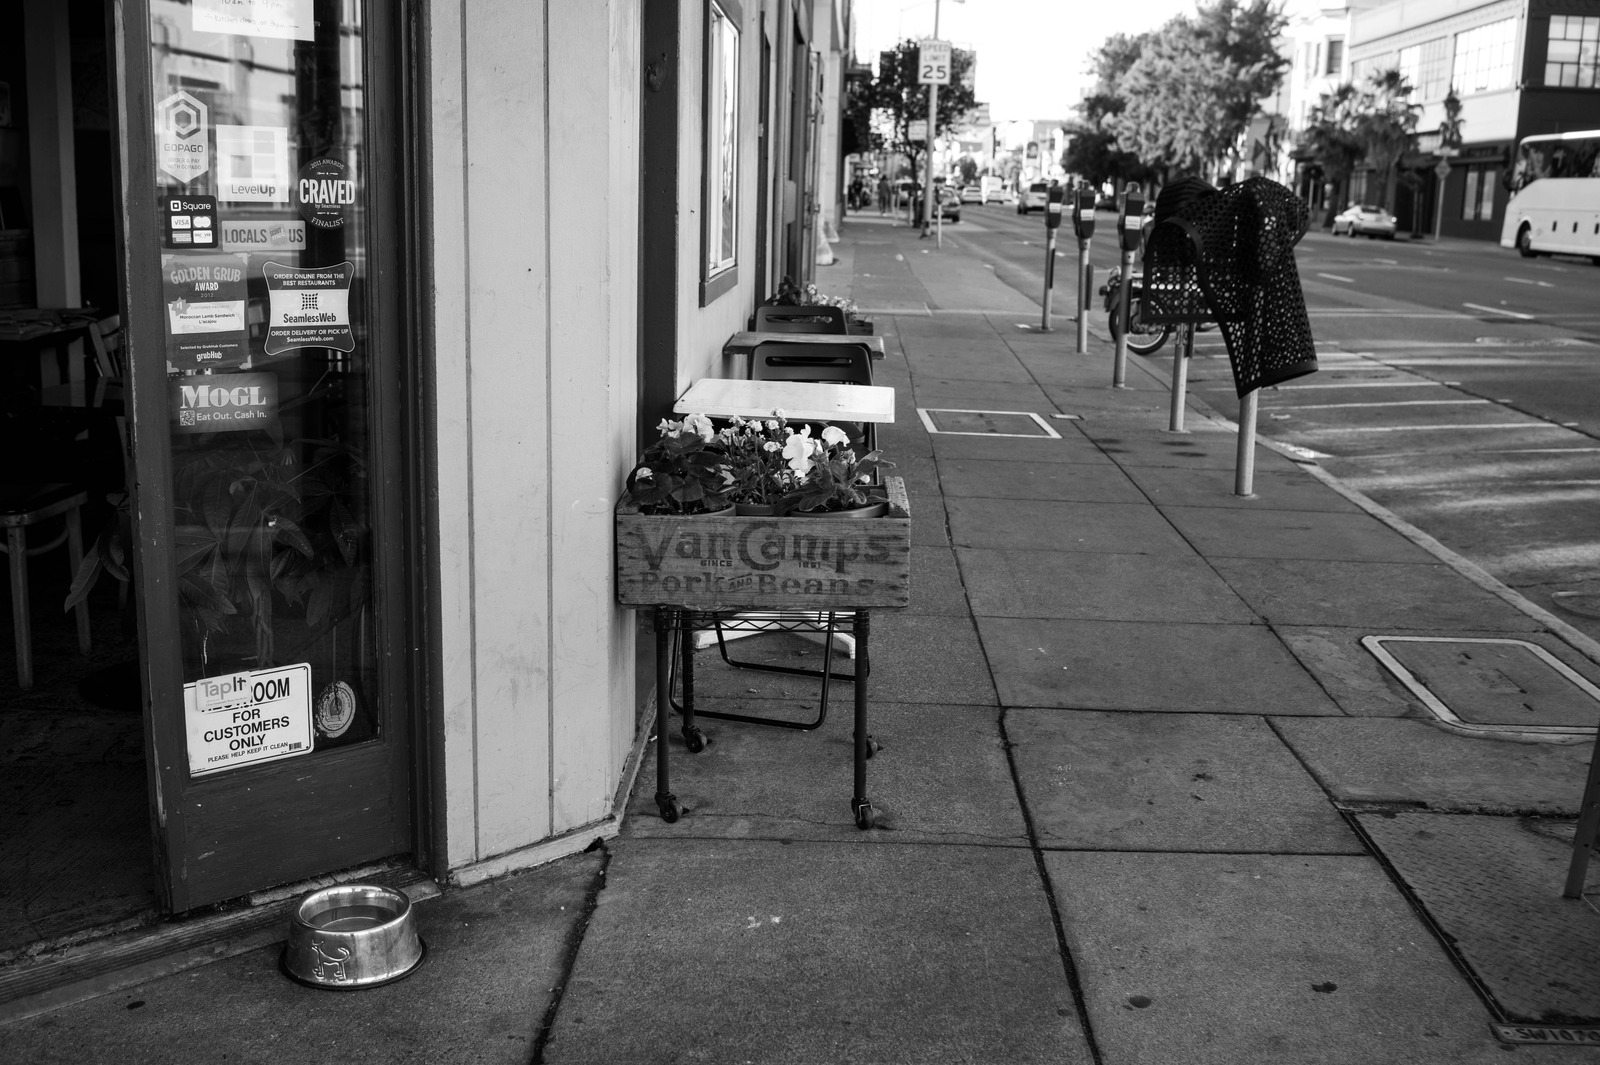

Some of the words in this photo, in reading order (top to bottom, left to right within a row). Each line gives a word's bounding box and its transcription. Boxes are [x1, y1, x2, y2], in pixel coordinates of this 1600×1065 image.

[922, 65, 947, 80] 25
[164, 143, 204, 154] GOPAGO
[322, 159, 344, 170] AWARDS
[231, 184, 276, 197] LevelUp
[300, 178, 355, 204] CRAVED
[182, 202, 212, 212] Square
[311, 217, 344, 228] FINALIST
[224, 229, 267, 243] LOCALS
[288, 229, 304, 243] US
[171, 267, 211, 285] GOLDEN
[213, 267, 241, 282] GRUB
[195, 282, 219, 291] AWARD
[283, 312, 337, 324] SeamlessWeb
[286, 335, 334, 343] SeamlessWeb.com
[180, 384, 267, 409] MOGL
[196, 412, 211, 421] Eat
[213, 411, 232, 421] Out.
[234, 410, 255, 420] Cash
[257, 410, 267, 418] In.
[700, 559, 733, 568] SINCE
[798, 561, 822, 569] 1861
[638, 571, 724, 594] Pork
[757, 572, 875, 595] Beans
[200, 676, 247, 700] TapIt
[233, 709, 260, 724] FOR
[204, 716, 290, 743] CUSTOMERS
[229, 733, 266, 751] ONLY
[207, 754, 229, 763] PLEASE
[231, 750, 246, 760] HELP
[247, 747, 262, 756] KEEP
[269, 742, 288, 751] CLEAN
